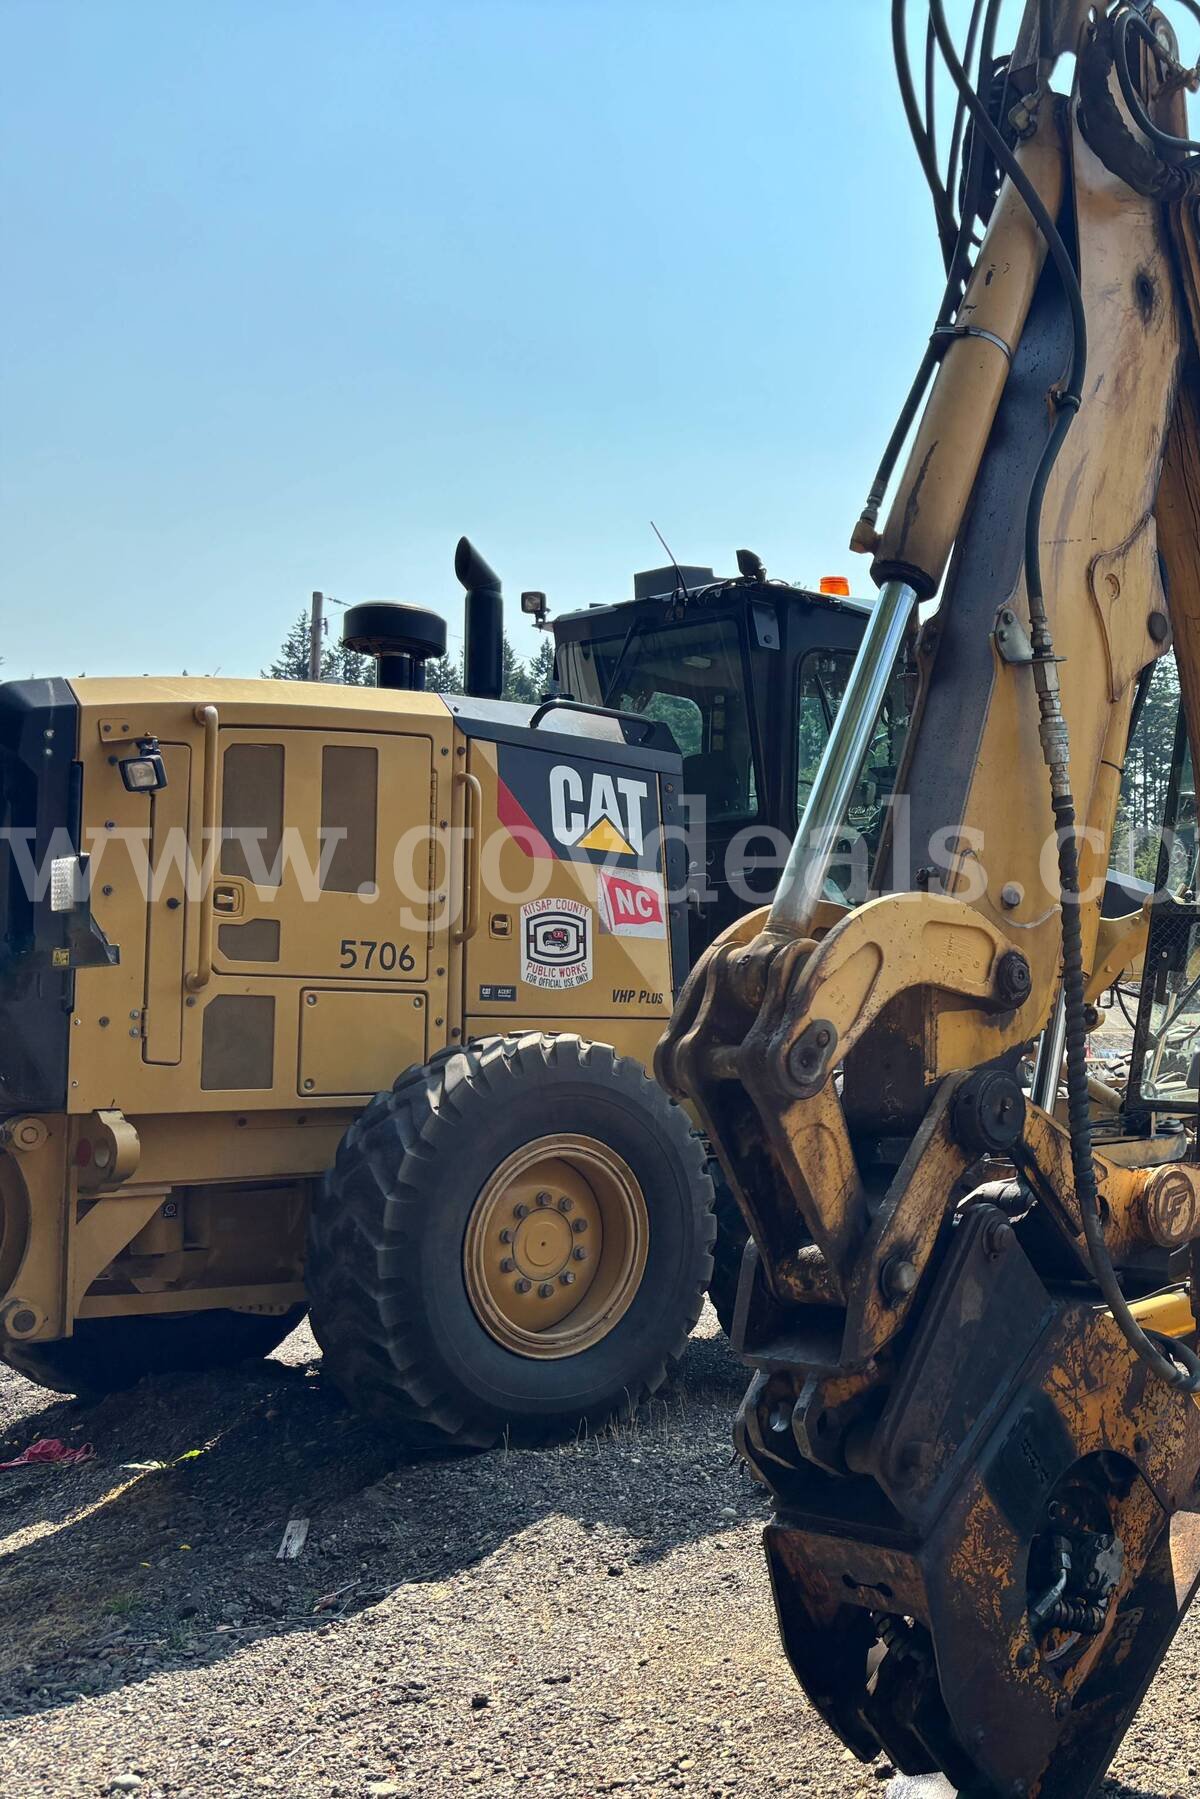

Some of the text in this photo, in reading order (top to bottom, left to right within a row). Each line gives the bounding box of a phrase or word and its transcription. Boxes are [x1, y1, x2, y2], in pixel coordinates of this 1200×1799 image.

[549, 765, 648, 857] CAT
[522, 899, 590, 917] KITSAP COUNTY
[614, 887, 653, 918] NC
[339, 939, 416, 972] 5706
[526, 961, 588, 978] PUBLIC WORKS
[525, 972, 589, 988] FOR OFFICIAL USE ONLY
[612, 989, 636, 1003] VHP
